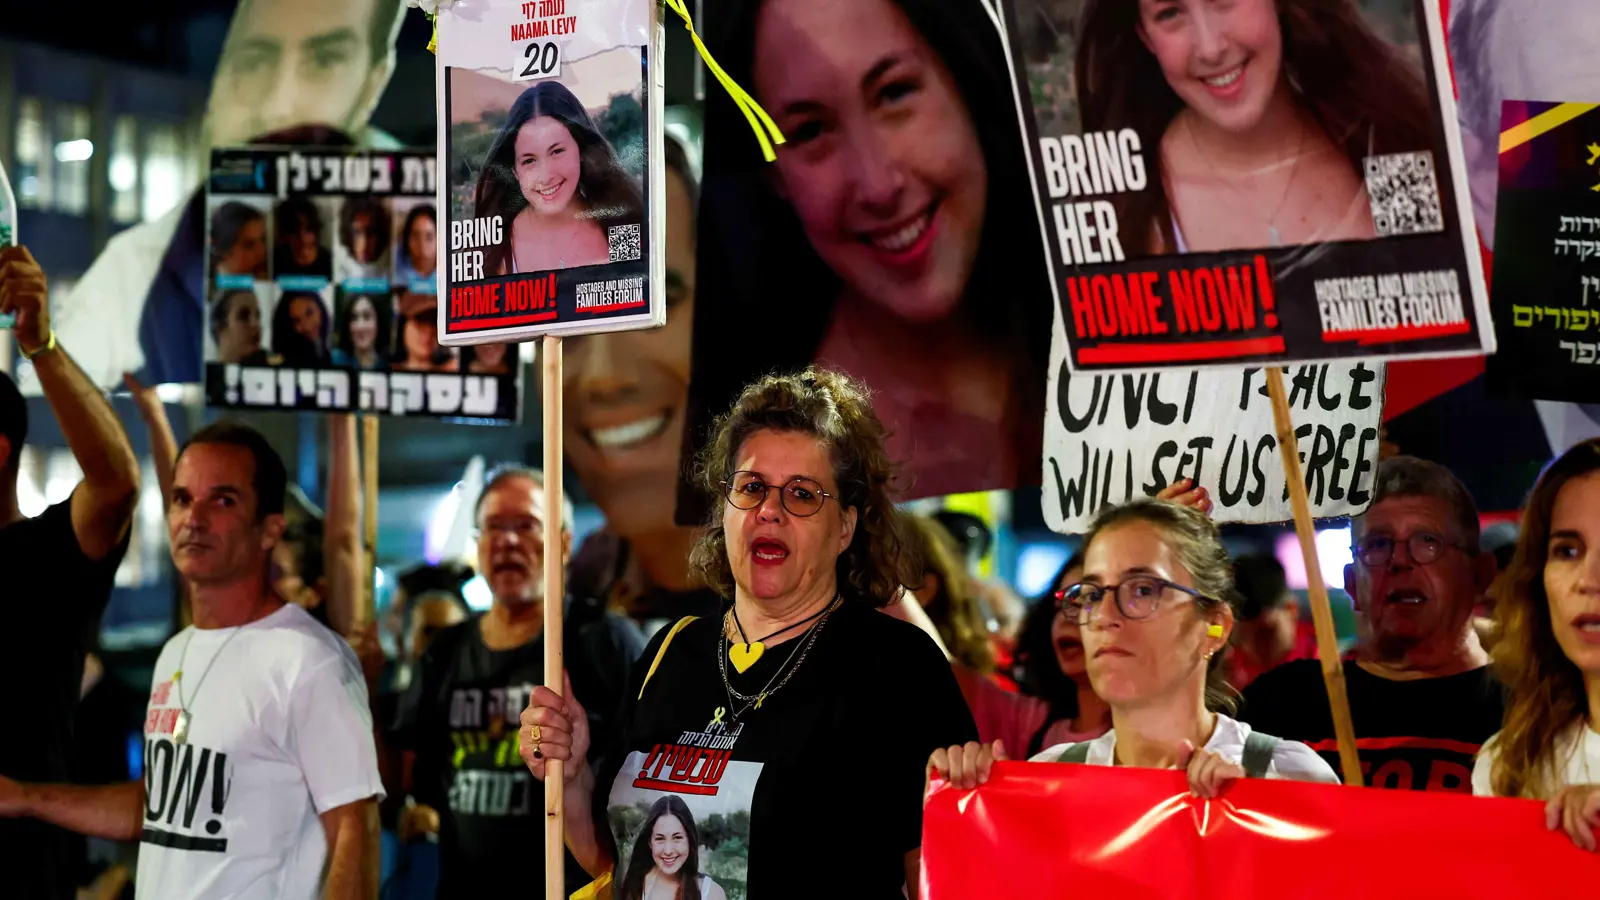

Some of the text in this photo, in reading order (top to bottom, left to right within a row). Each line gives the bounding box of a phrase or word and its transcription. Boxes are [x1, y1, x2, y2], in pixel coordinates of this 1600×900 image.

[511, 16, 577, 41] NAAMA LEVY
[521, 0, 565, 19] נעמה לוי
[520, 42, 558, 77] 20
[276, 152, 395, 199] בשבילן
[1039, 128, 1147, 198] BRING
[451, 215, 503, 250] BRING
[1052, 200, 1126, 265] HER
[451, 251, 485, 283] HER
[1314, 268, 1460, 301] HOSTAGES AND MISSING
[451, 283, 500, 318] HOME
[505, 273, 557, 312] NOW!
[576, 278, 643, 295] HOSTAGES AND MISSING
[576, 286, 643, 309] FAMILIES FORUM
[1066, 254, 1278, 338] HOME NOW!
[1319, 291, 1465, 332] FAMILIES FORUM
[1512, 304, 1600, 331] יפורים
[224, 364, 498, 414] עסקה היום!
[1239, 362, 1375, 411] PACE
[1142, 436, 1214, 496] SET
[1218, 433, 1276, 507] US
[677, 730, 738, 750] אותם הביתה
[638, 743, 733, 785] עכשיו!
